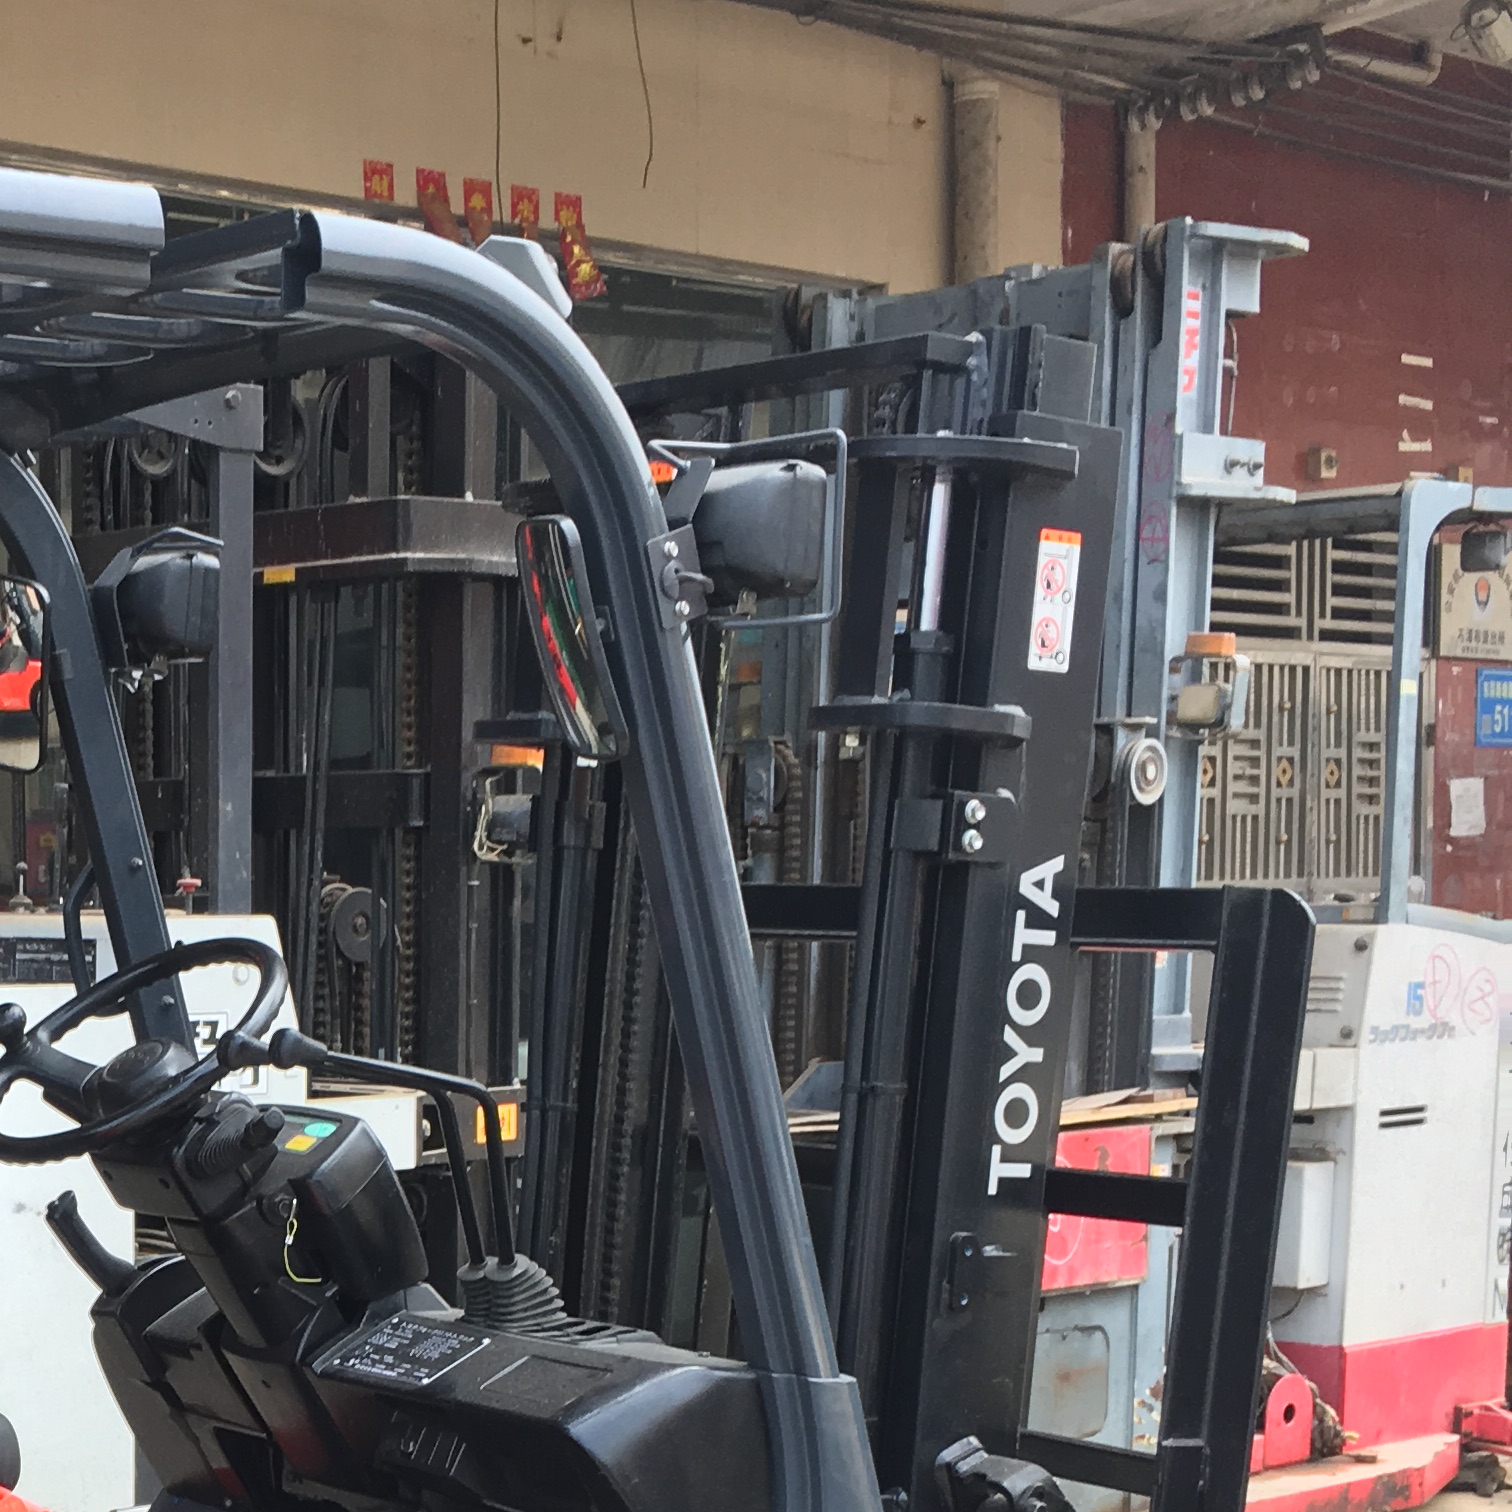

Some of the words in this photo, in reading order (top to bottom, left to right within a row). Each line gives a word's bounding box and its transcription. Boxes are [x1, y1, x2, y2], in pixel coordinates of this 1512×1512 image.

[1494, 704, 1512, 734] 51
[1406, 980, 1426, 1017] 15
[988, 854, 1065, 1195] TOYOTA
